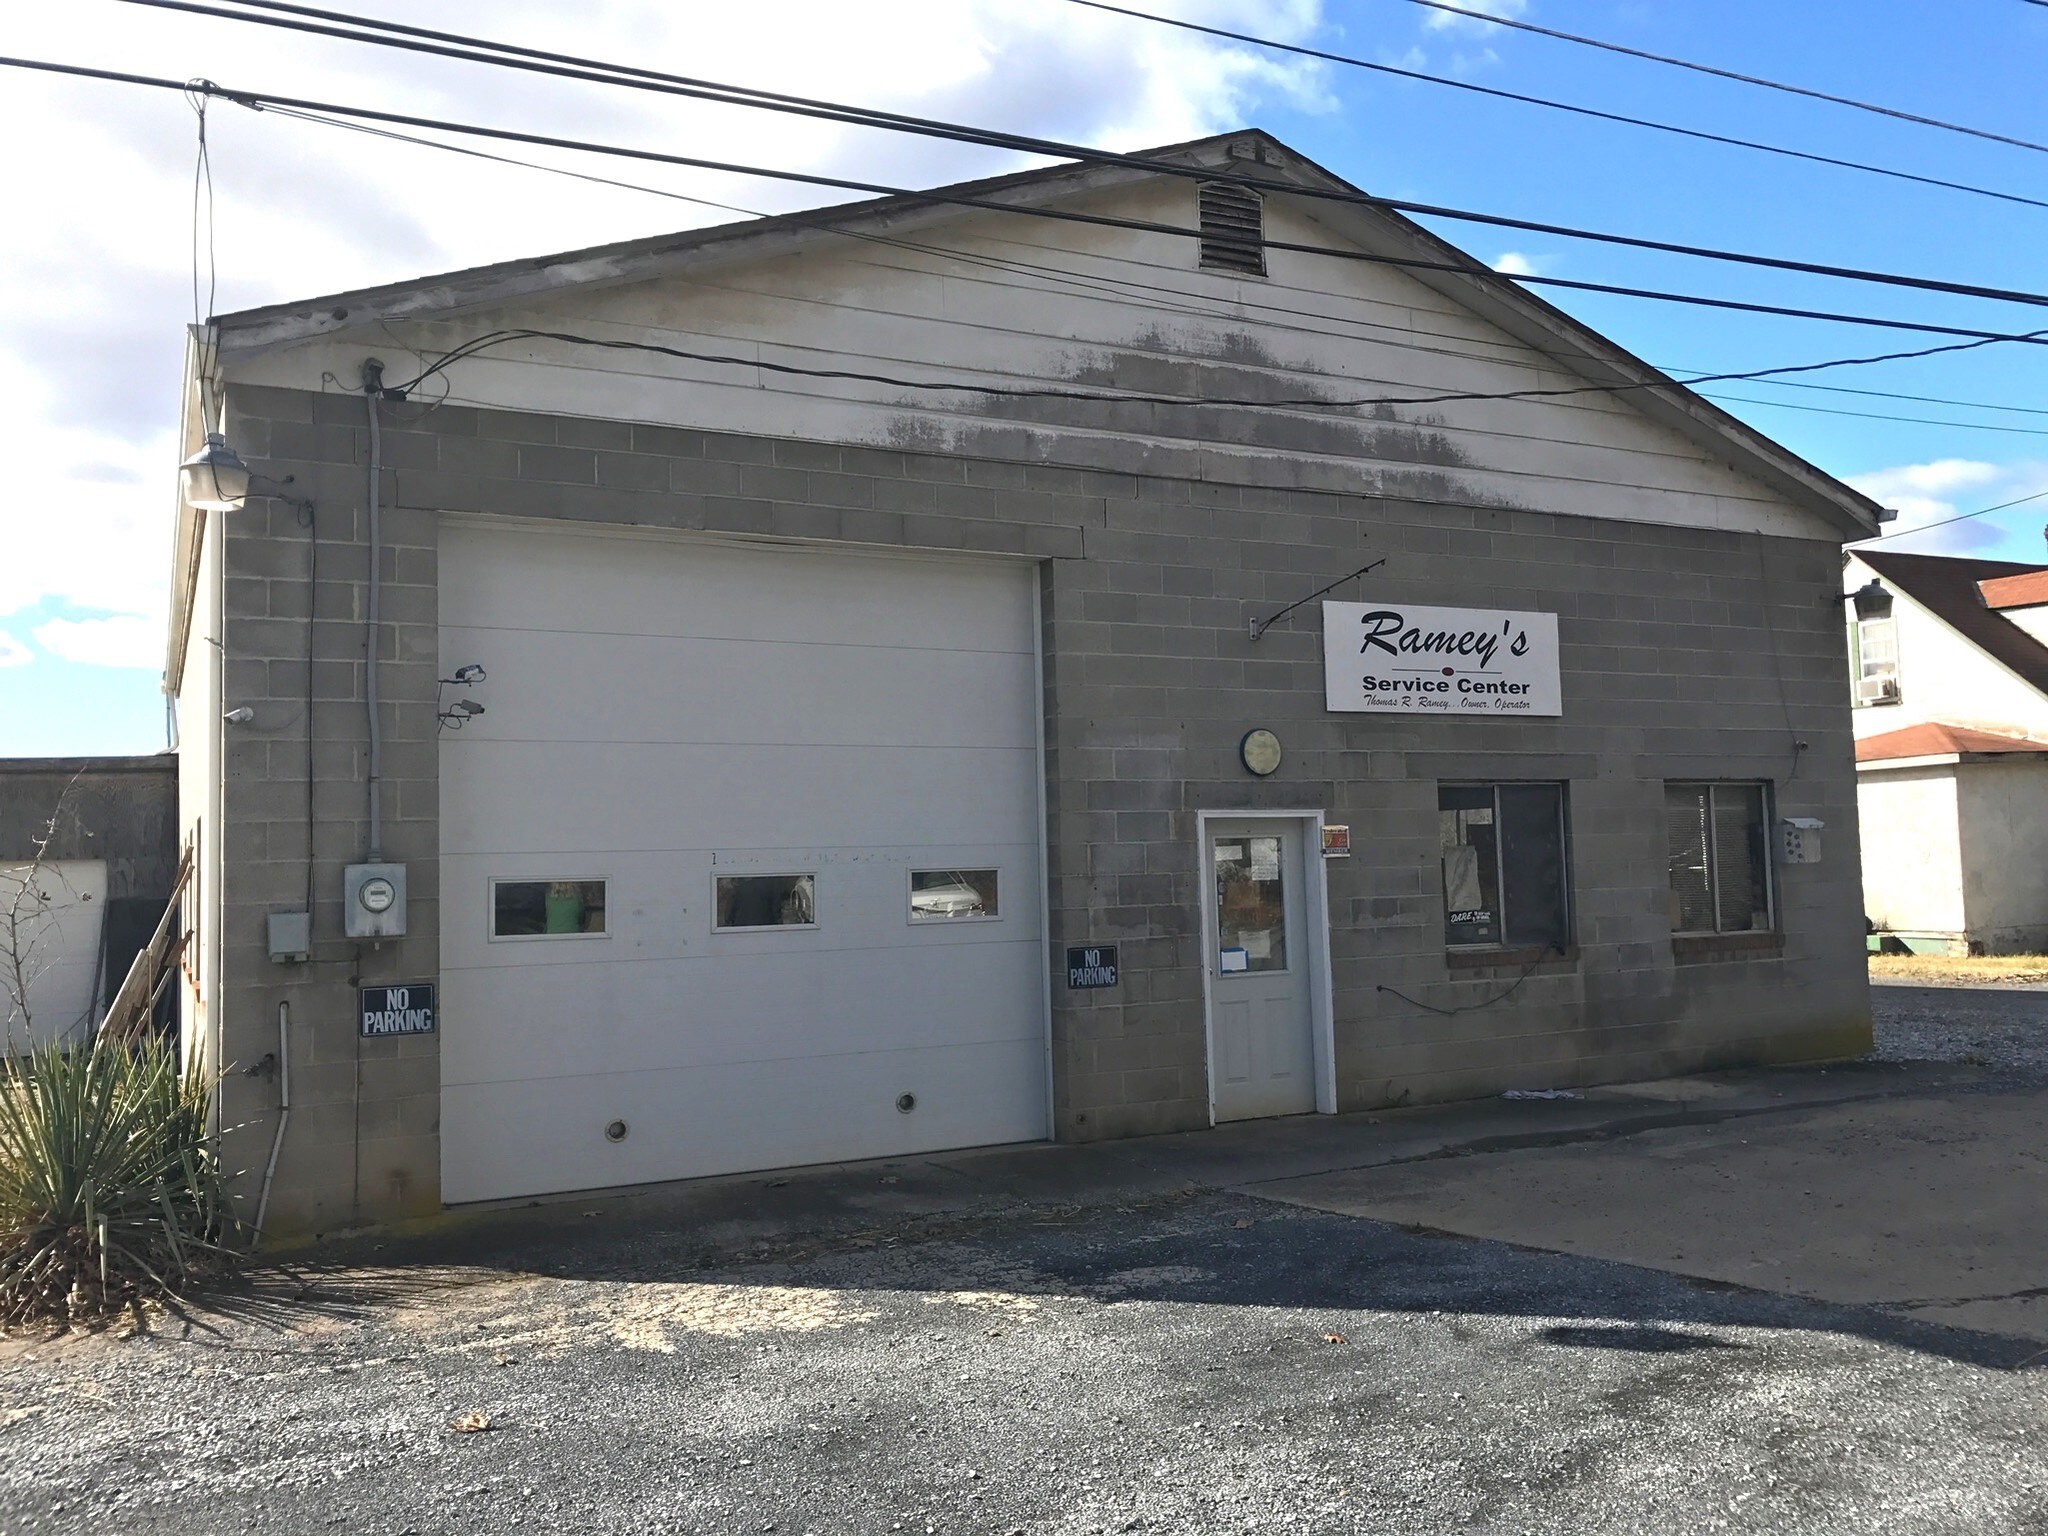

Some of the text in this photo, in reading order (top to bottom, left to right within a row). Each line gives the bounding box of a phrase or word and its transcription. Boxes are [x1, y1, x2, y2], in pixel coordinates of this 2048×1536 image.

[1360, 611, 1530, 669] Ramey's
[1362, 675, 1531, 695] Service Center
[1364, 694, 1398, 707] Thomas
[1401, 696, 1413, 708] R.
[1494, 698, 1530, 711] Operator
[1084, 949, 1100, 967] NO
[1070, 966, 1115, 986] PARKING
[386, 988, 409, 1010] NO
[364, 1008, 431, 1033] PARKING
